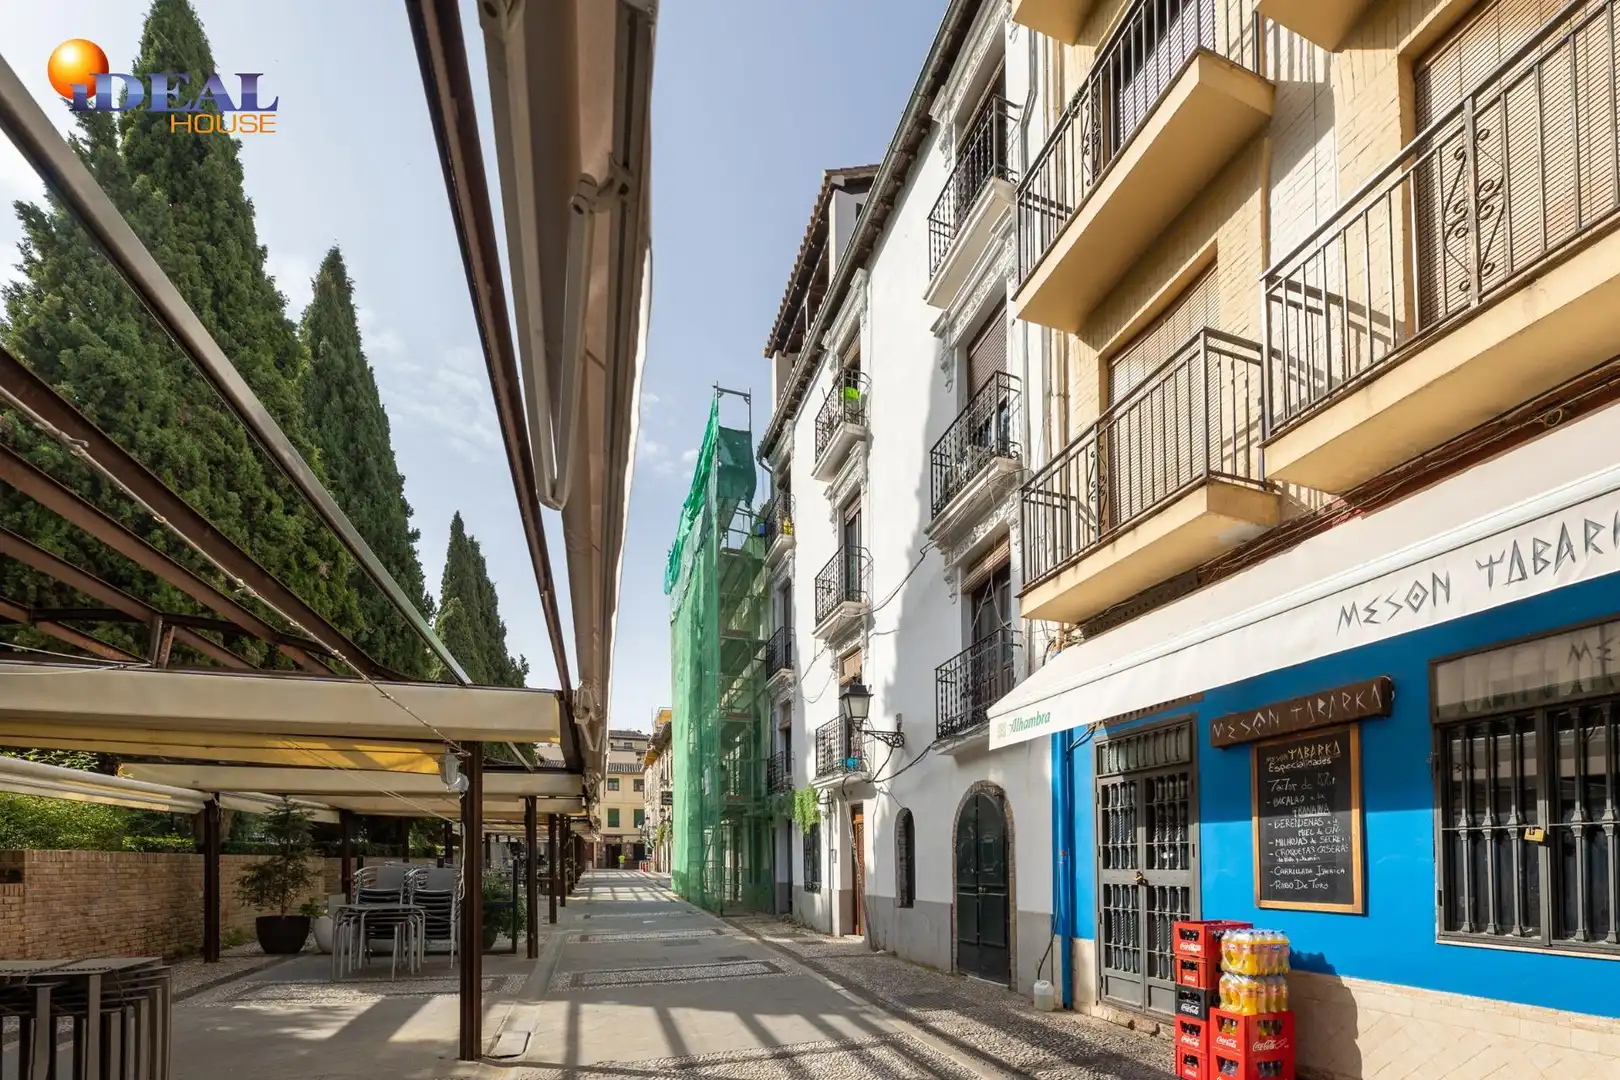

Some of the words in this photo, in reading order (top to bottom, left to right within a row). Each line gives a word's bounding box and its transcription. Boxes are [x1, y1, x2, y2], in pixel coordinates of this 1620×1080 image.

[1336, 570, 1451, 636] MESON
[1212, 708, 1280, 739] MESON
[1290, 683, 1383, 723] TABARKA
[1008, 711, 1051, 736] Alhambra
[1288, 740, 1341, 760] TABARKA
[1275, 836, 1308, 847] MILHOJAS
[1298, 829, 1315, 837] MIEL
[1274, 846, 1315, 858] CROQUETAS
